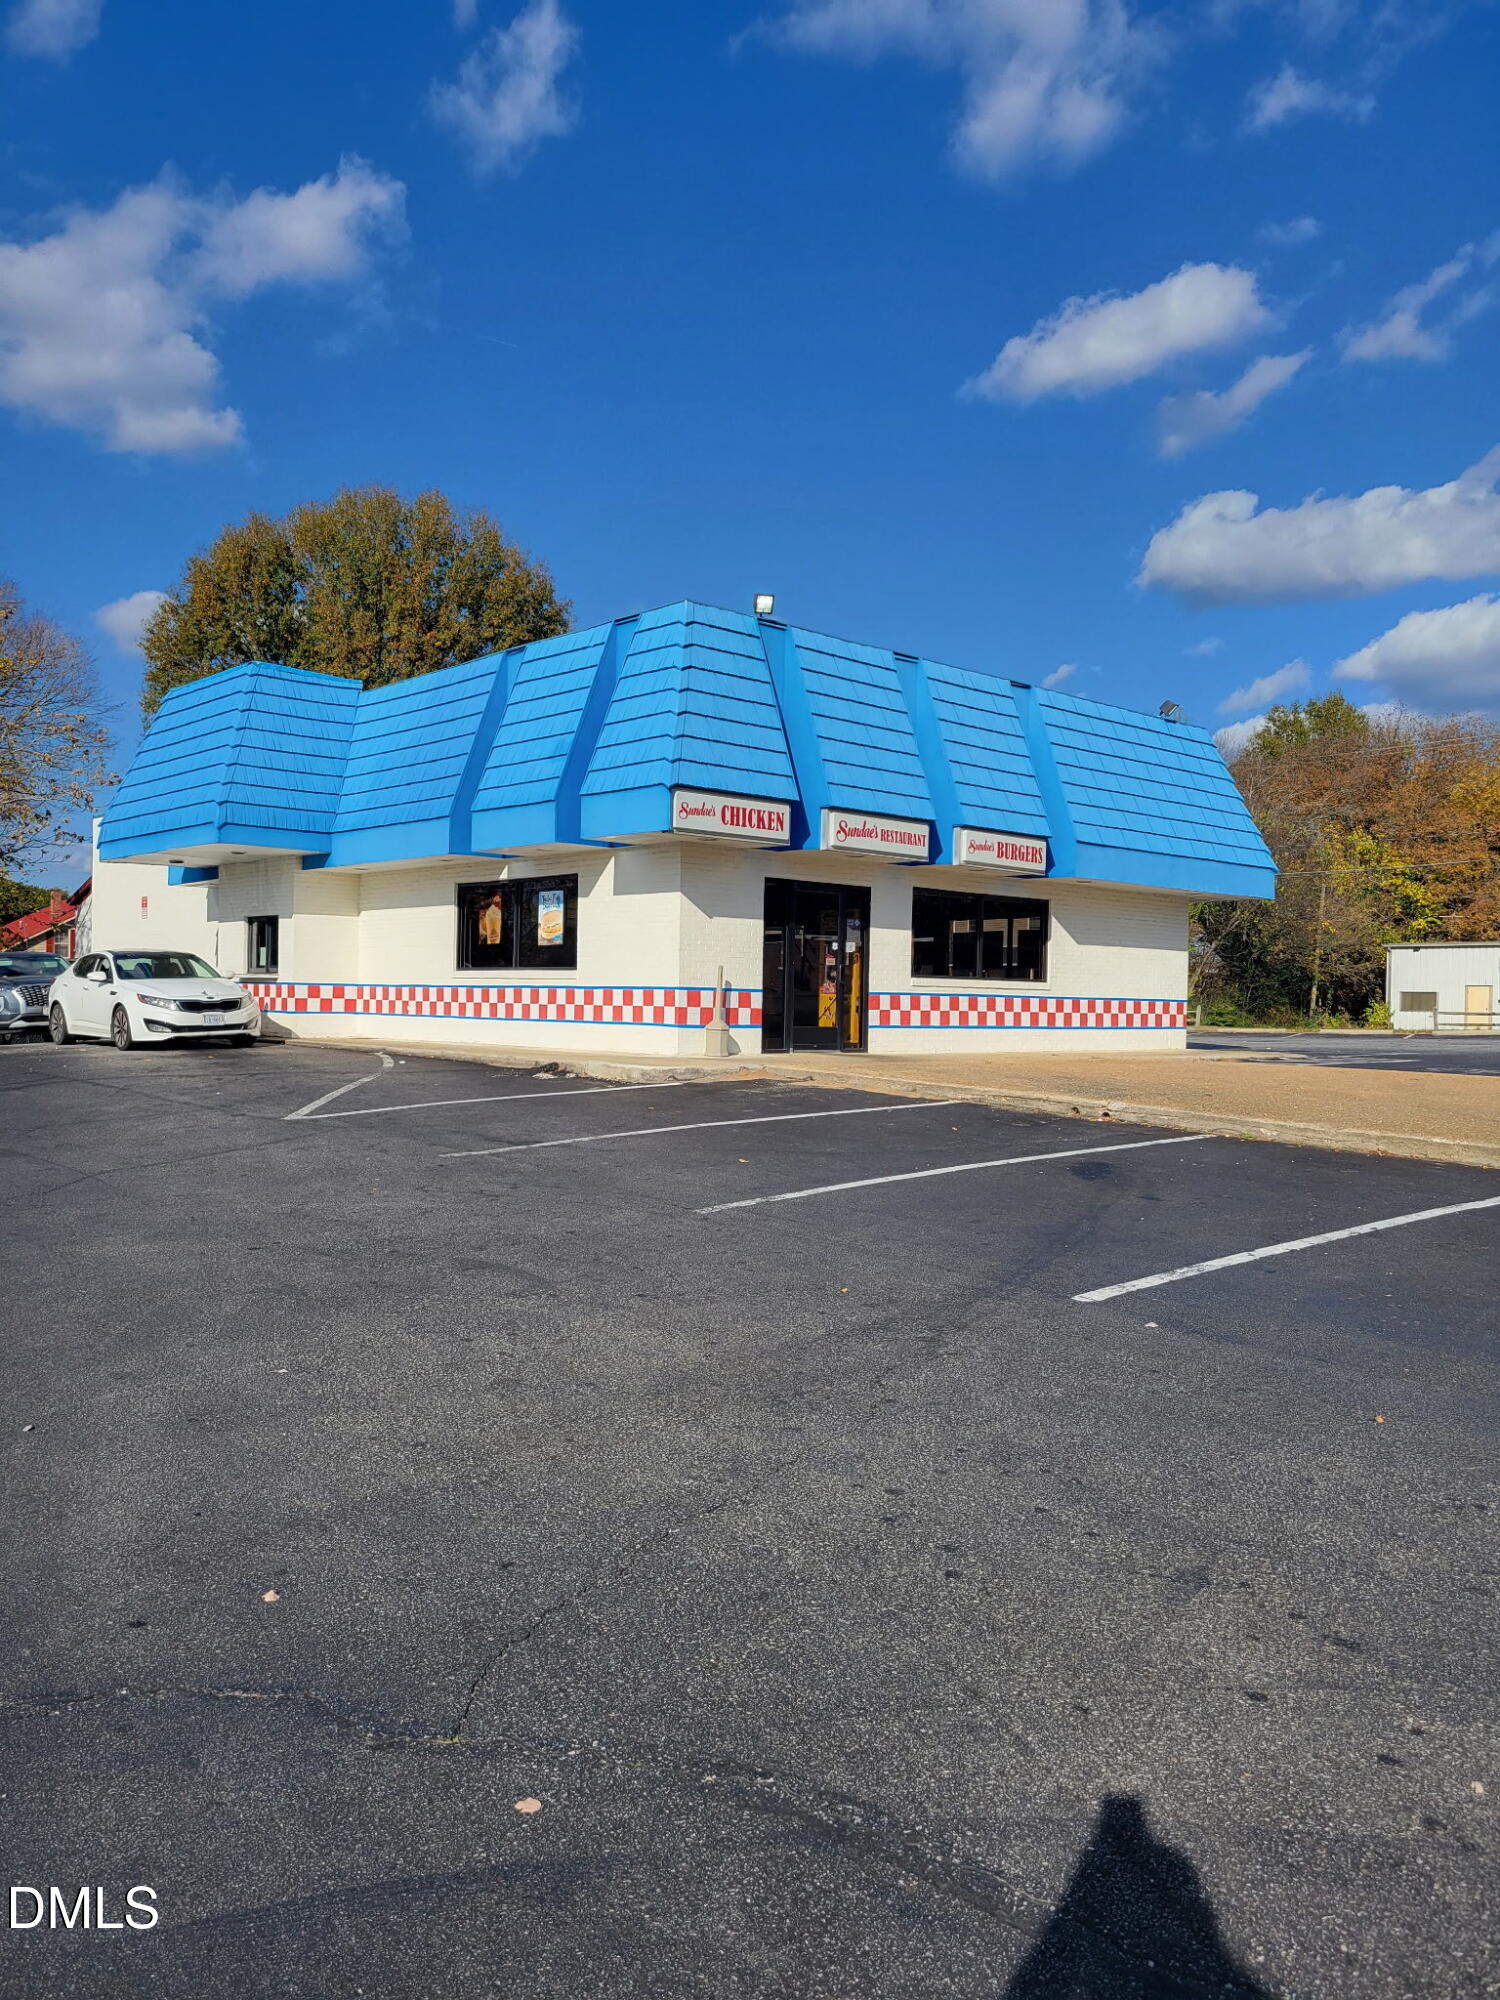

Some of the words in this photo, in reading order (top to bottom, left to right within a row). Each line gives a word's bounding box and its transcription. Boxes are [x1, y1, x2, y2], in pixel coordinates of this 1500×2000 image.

[679, 802, 716, 819] Sundae's
[721, 805, 784, 832] CHICKEN
[836, 820, 878, 842] Sundae's
[880, 829, 926, 847] RESTAURANT
[997, 842, 1042, 864] BURGERS
